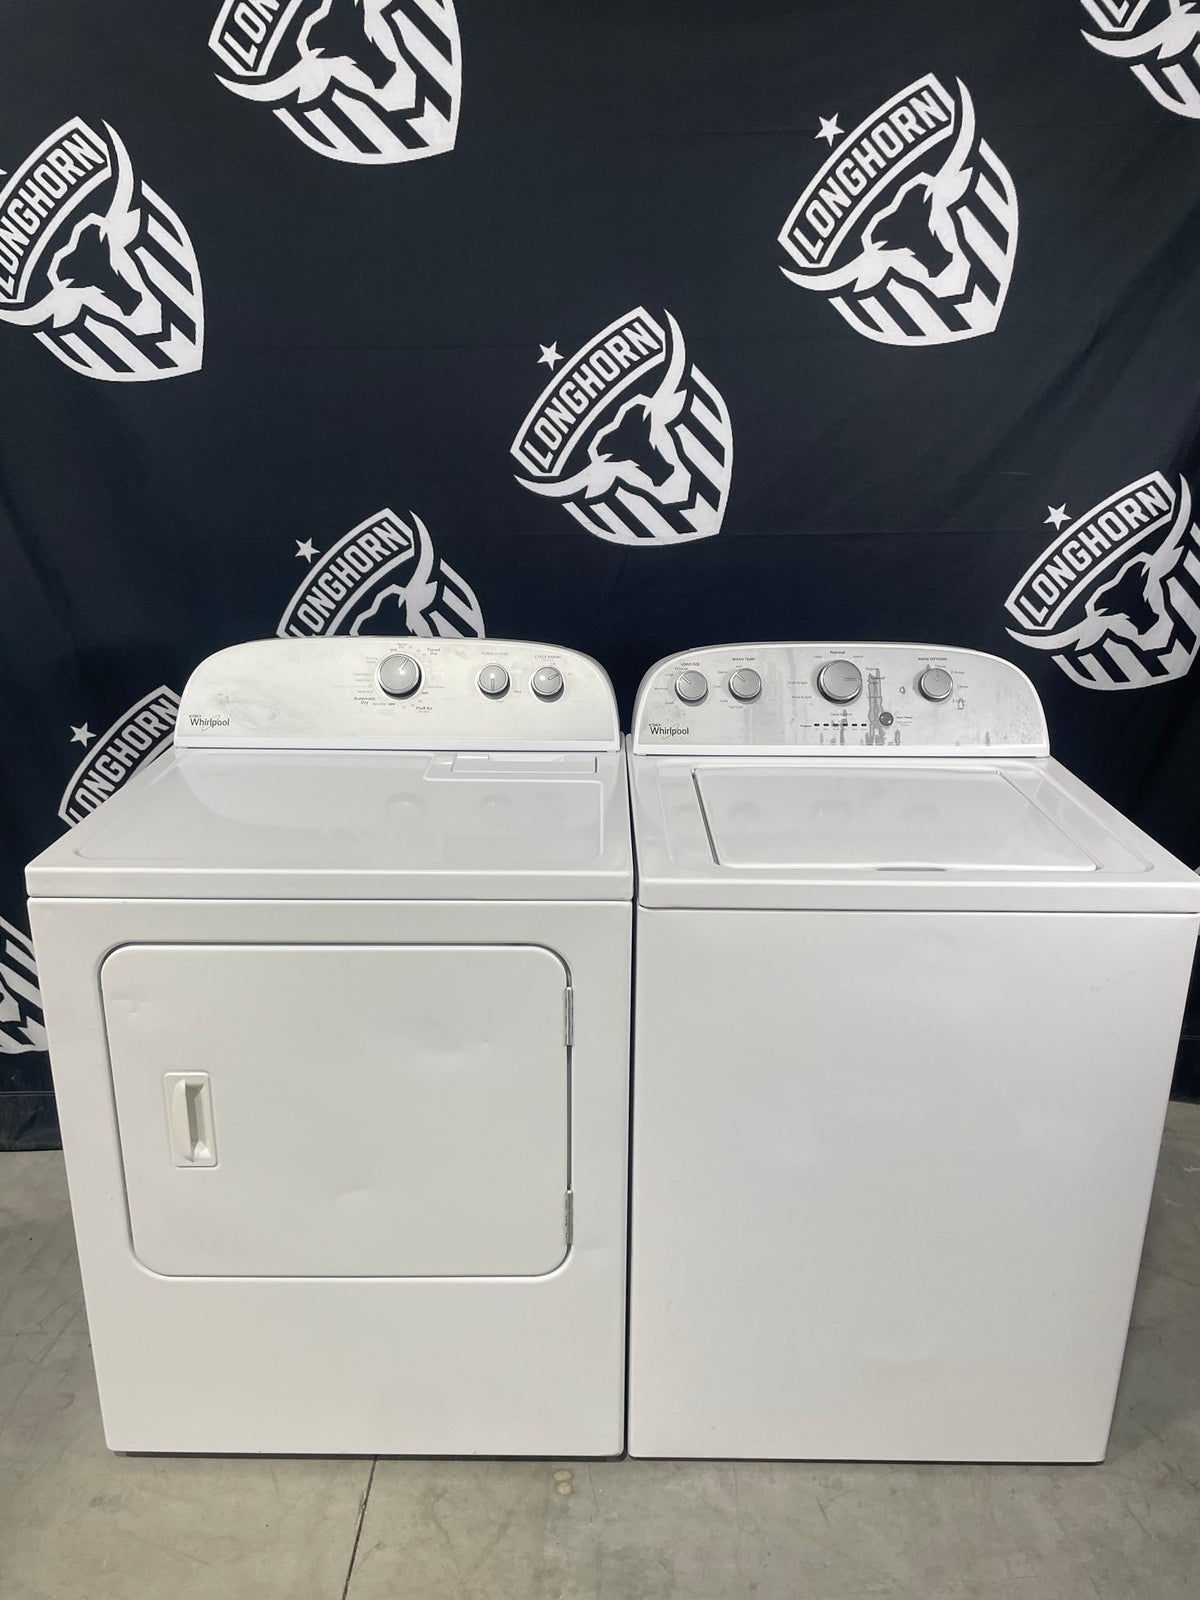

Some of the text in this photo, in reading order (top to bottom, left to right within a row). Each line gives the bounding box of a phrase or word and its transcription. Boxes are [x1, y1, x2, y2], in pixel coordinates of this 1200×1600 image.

[792, 89, 949, 261] LONGHORN
[523, 321, 662, 471] LONGHORN
[1019, 484, 1170, 624] LONGHORN
[189, 717, 231, 729] Whirlpool
[649, 726, 690, 737] Whirlpool
